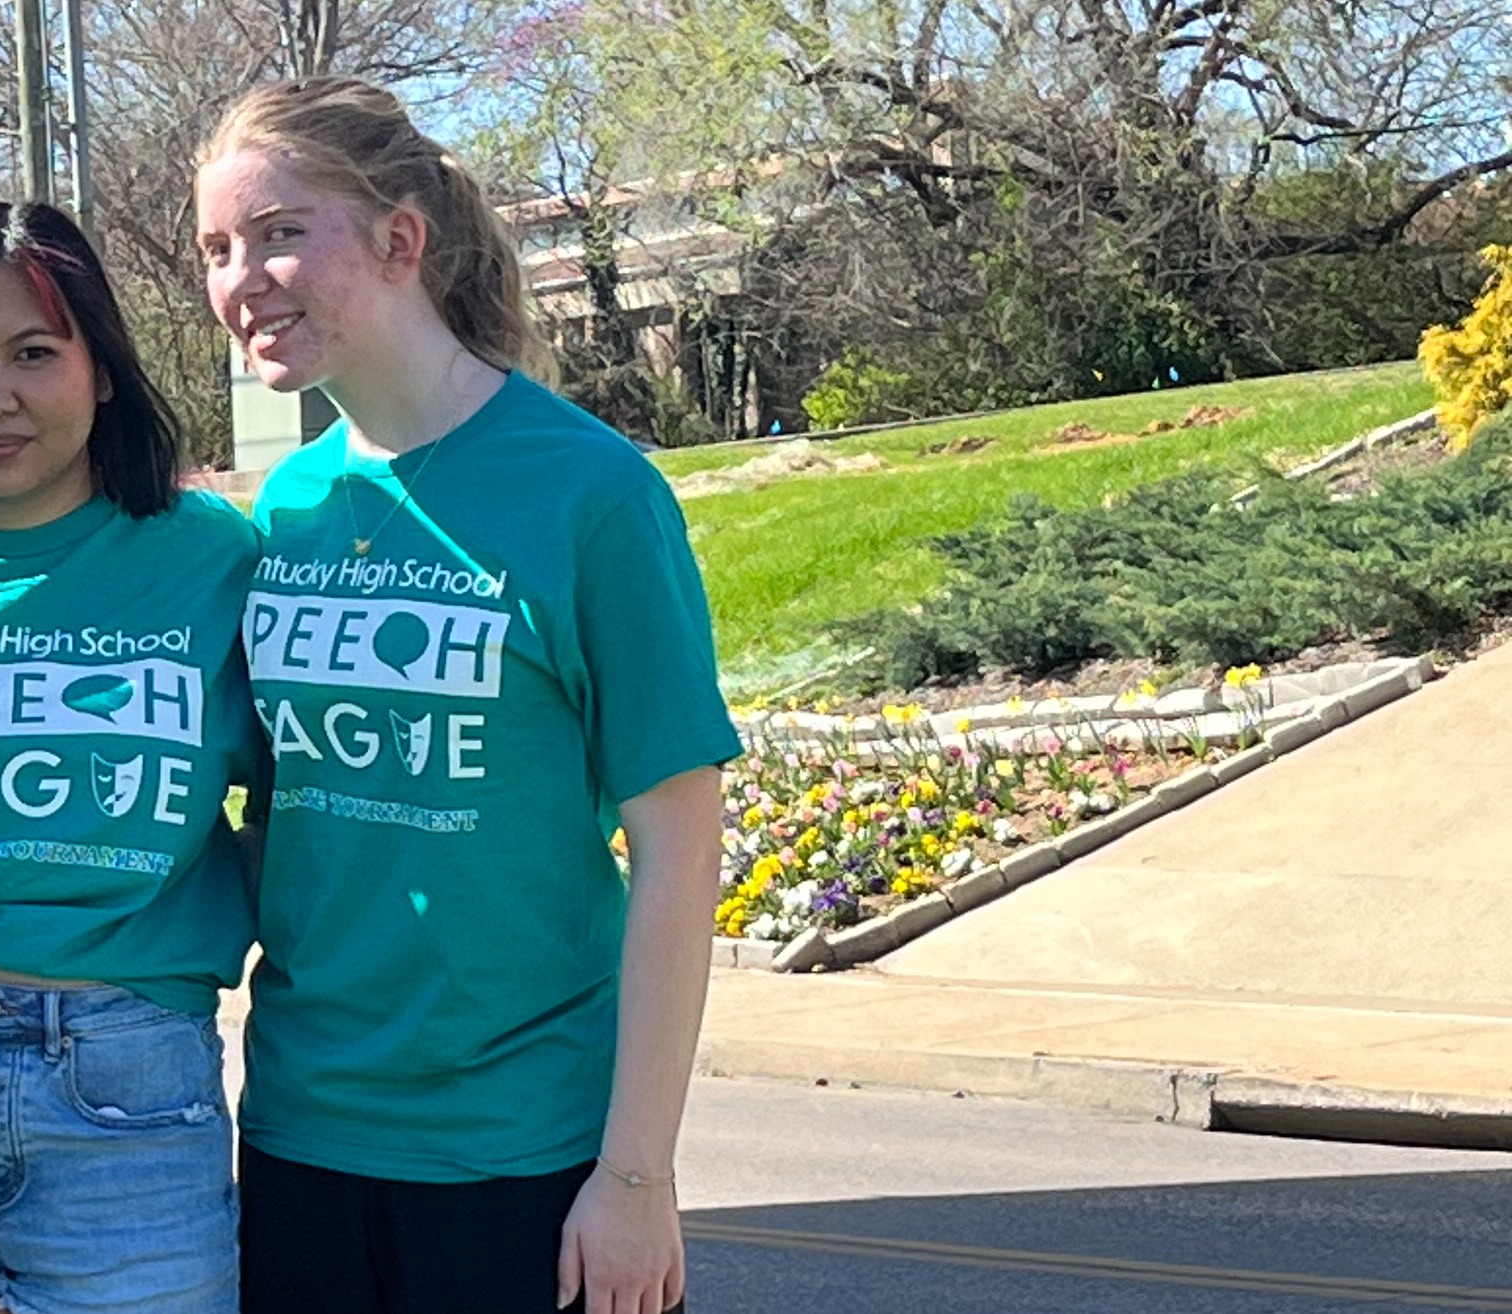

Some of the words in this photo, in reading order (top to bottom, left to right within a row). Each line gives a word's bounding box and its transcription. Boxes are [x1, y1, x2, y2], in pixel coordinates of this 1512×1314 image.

[253, 555, 337, 591] ntucky
[338, 558, 397, 594] High
[399, 559, 507, 599] School
[0, 625, 74, 658] High
[80, 625, 192, 656] School
